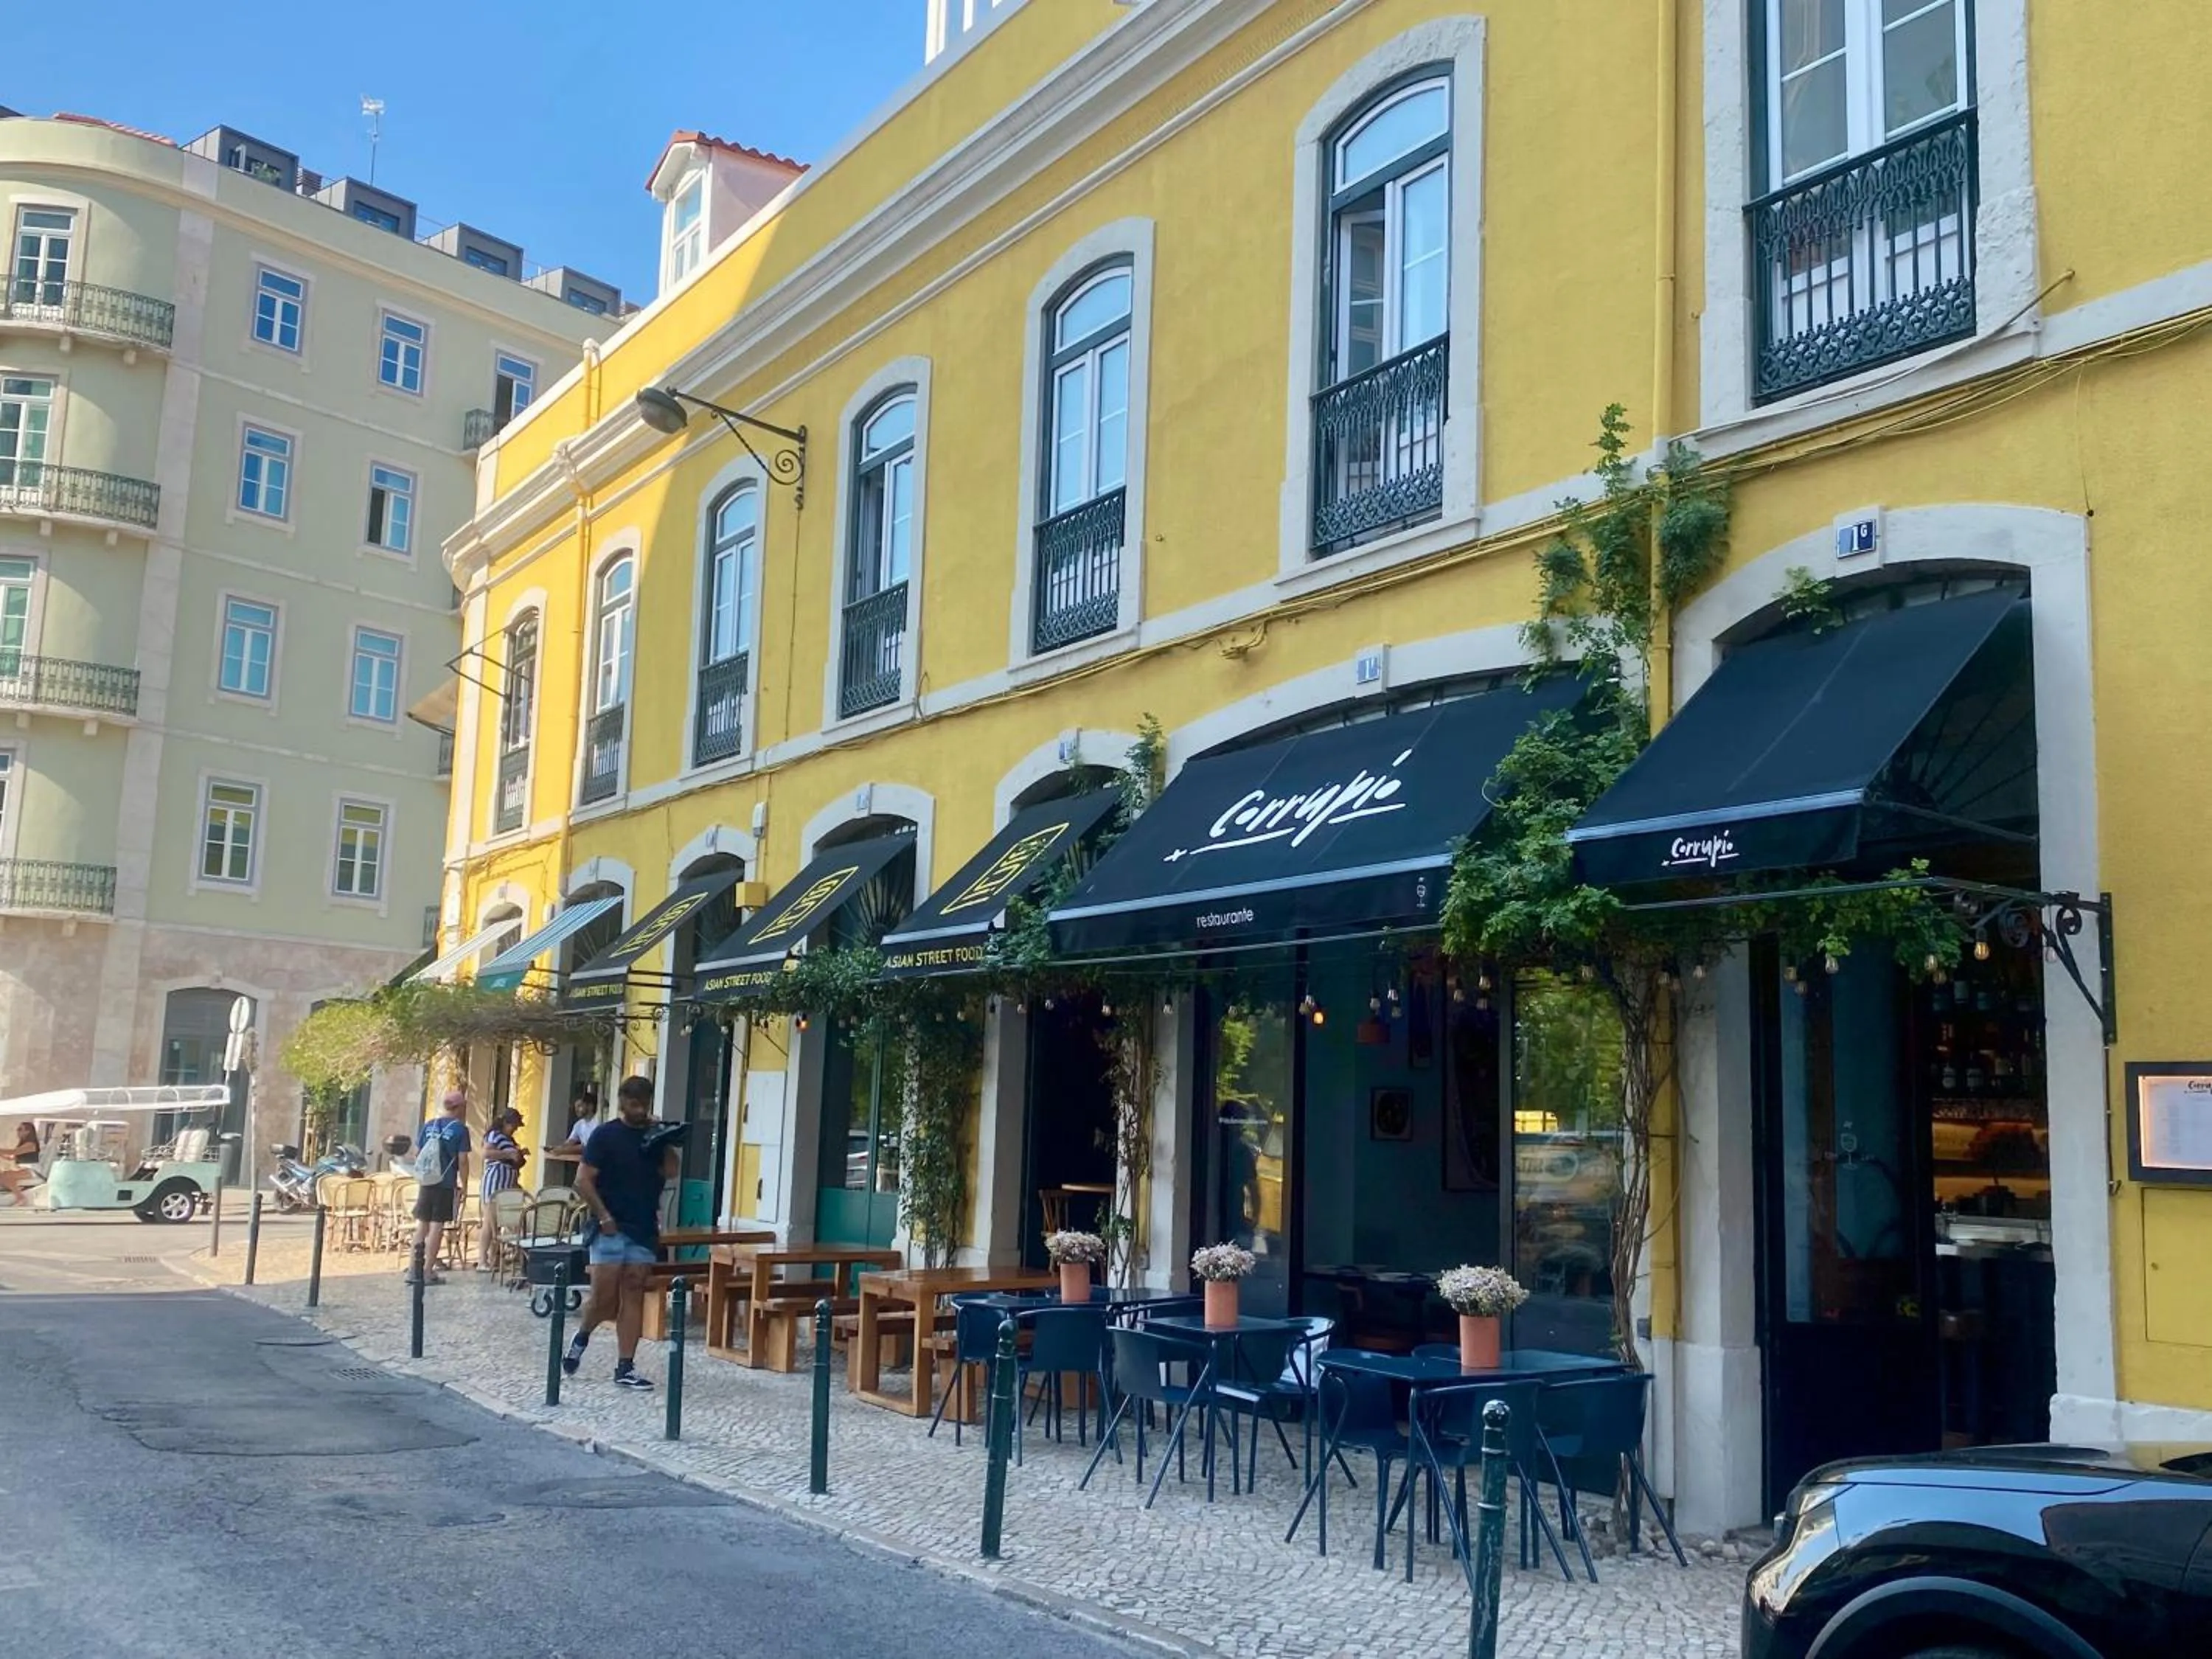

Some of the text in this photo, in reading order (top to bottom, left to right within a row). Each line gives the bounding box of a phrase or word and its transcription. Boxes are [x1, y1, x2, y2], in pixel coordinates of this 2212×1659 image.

[1851, 524, 1868, 552] 1G
[1671, 829, 1734, 868] Corrupio
[1196, 907, 1253, 928] restaurante
[884, 945, 984, 969] ASIAN STREET FOOD
[703, 978, 724, 992] ASIAN
[723, 973, 751, 989] STREET
